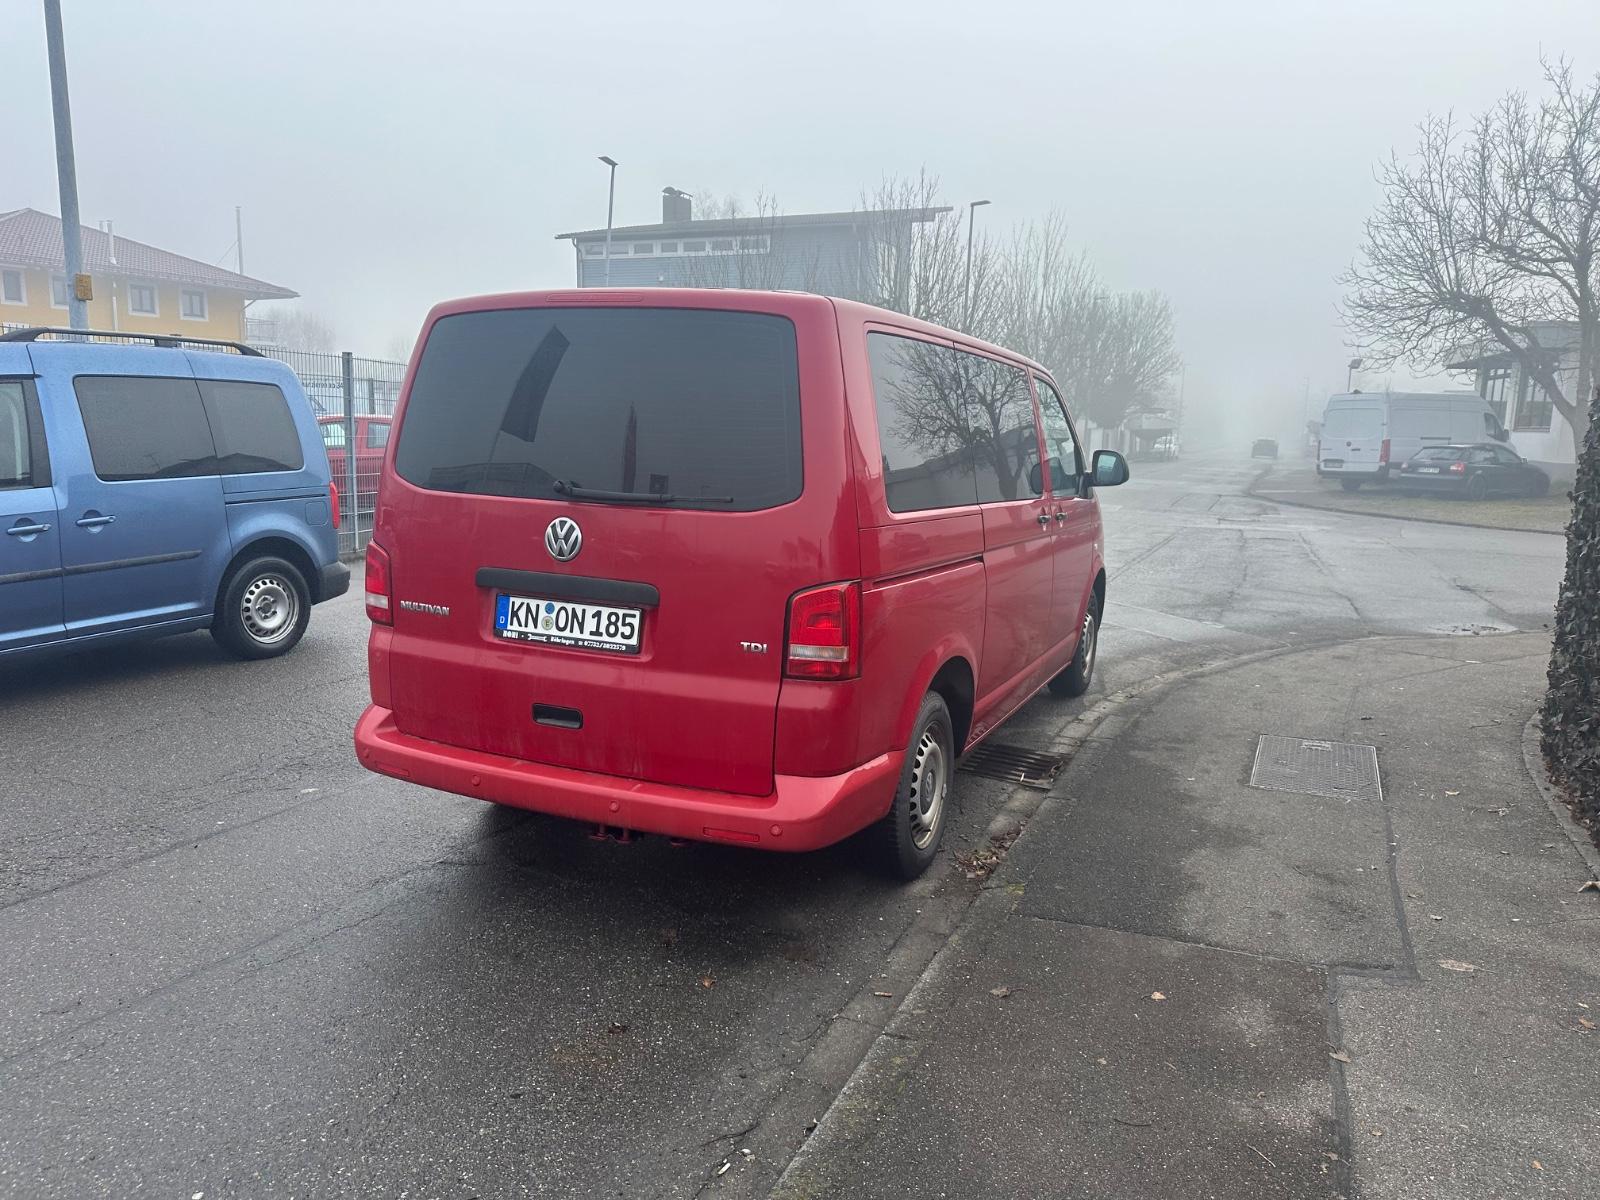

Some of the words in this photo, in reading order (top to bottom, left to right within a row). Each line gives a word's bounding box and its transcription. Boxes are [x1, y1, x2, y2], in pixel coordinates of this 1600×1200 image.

[400, 600, 450, 616] MULTIVAN
[500, 616, 505, 624] D
[509, 601, 540, 629] KN
[555, 606, 586, 635] ON
[589, 610, 637, 640] 185
[740, 641, 768, 654] TDI
